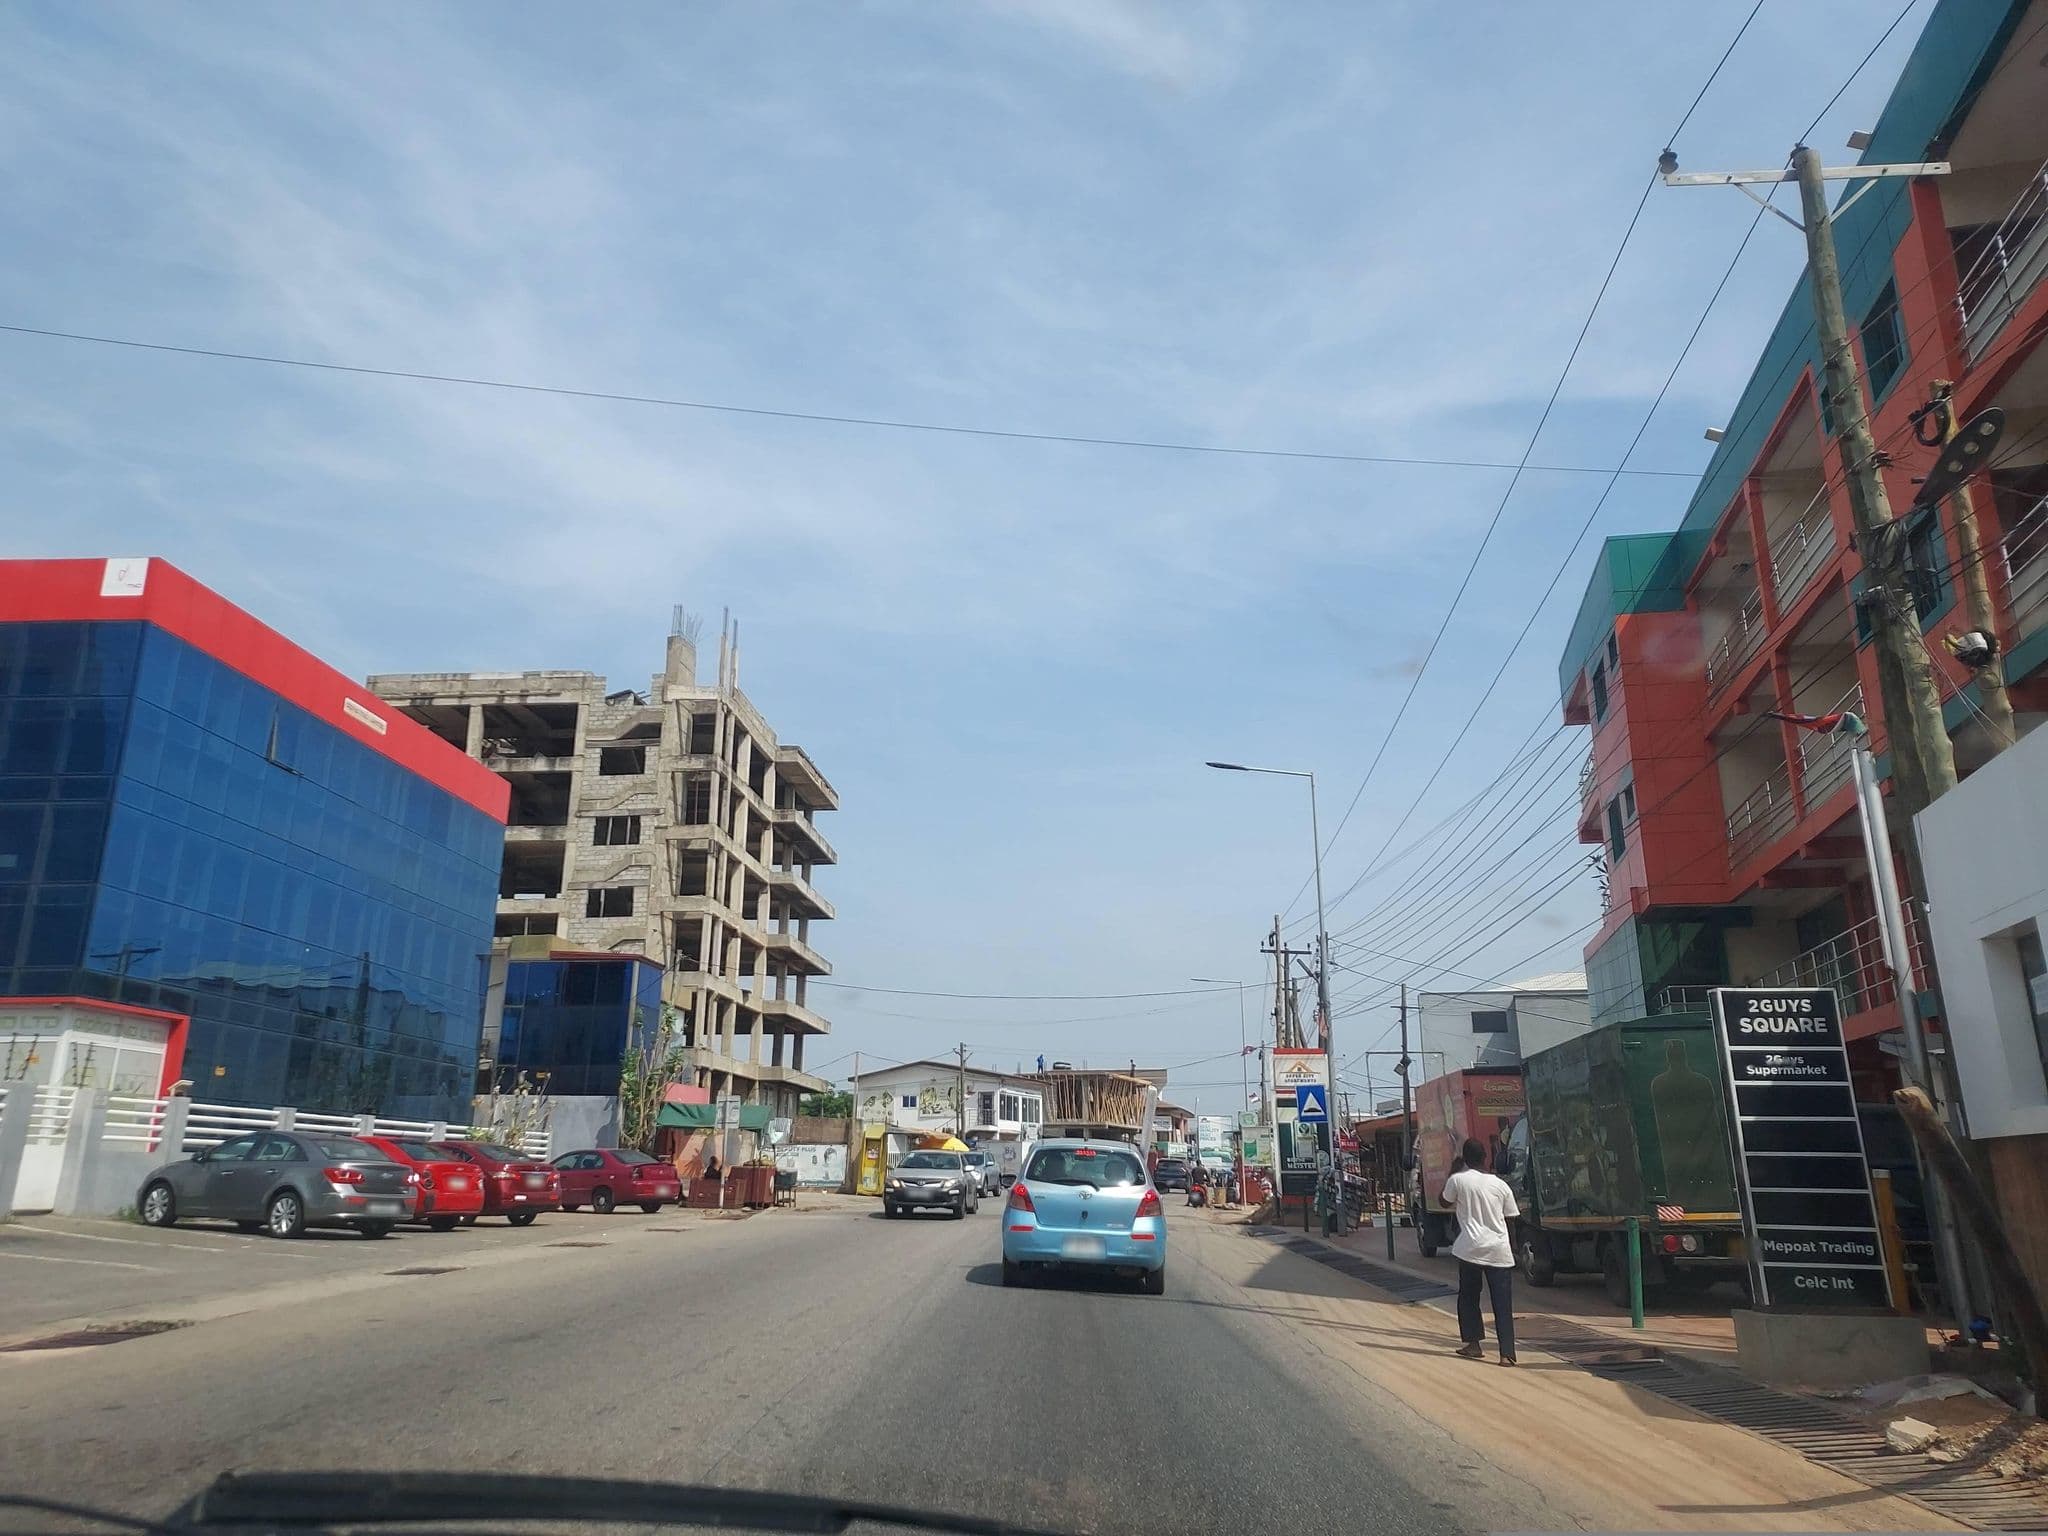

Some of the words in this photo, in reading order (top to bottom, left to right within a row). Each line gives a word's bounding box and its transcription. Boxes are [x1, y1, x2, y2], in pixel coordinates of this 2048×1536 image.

[1748, 999, 1812, 1013] 2GUYS
[1740, 1017, 1828, 1033] SQUARE
[1746, 1065, 1828, 1077] Supermarket
[1764, 1240, 1817, 1254] Mepoat
[1819, 1241, 1875, 1256] Trading
[1831, 1277, 1856, 1289] Int
